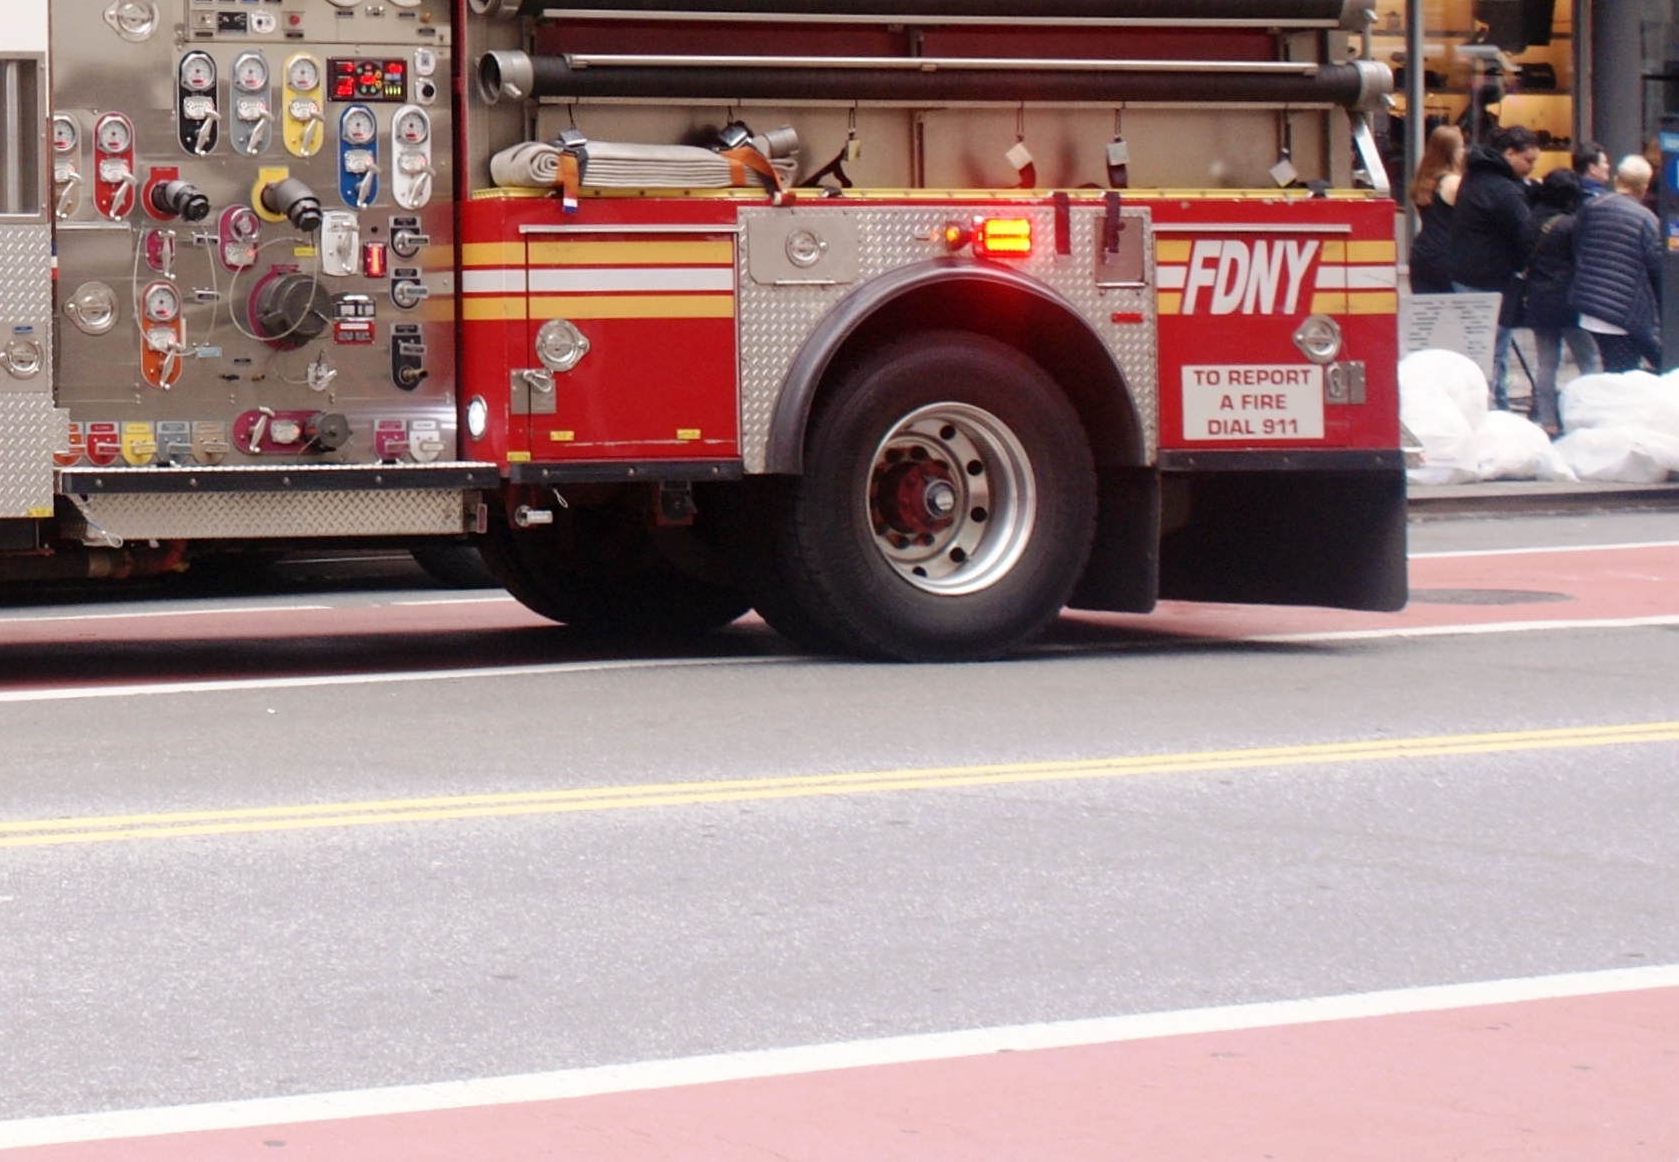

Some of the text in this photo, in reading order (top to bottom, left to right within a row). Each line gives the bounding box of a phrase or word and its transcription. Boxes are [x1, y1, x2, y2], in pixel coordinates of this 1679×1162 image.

[1181, 239, 1320, 315] FDNY
[1194, 369, 1312, 385] TO REPORT
[1220, 394, 1287, 410] A FIRE
[1208, 419, 1298, 435] DIAL 911
